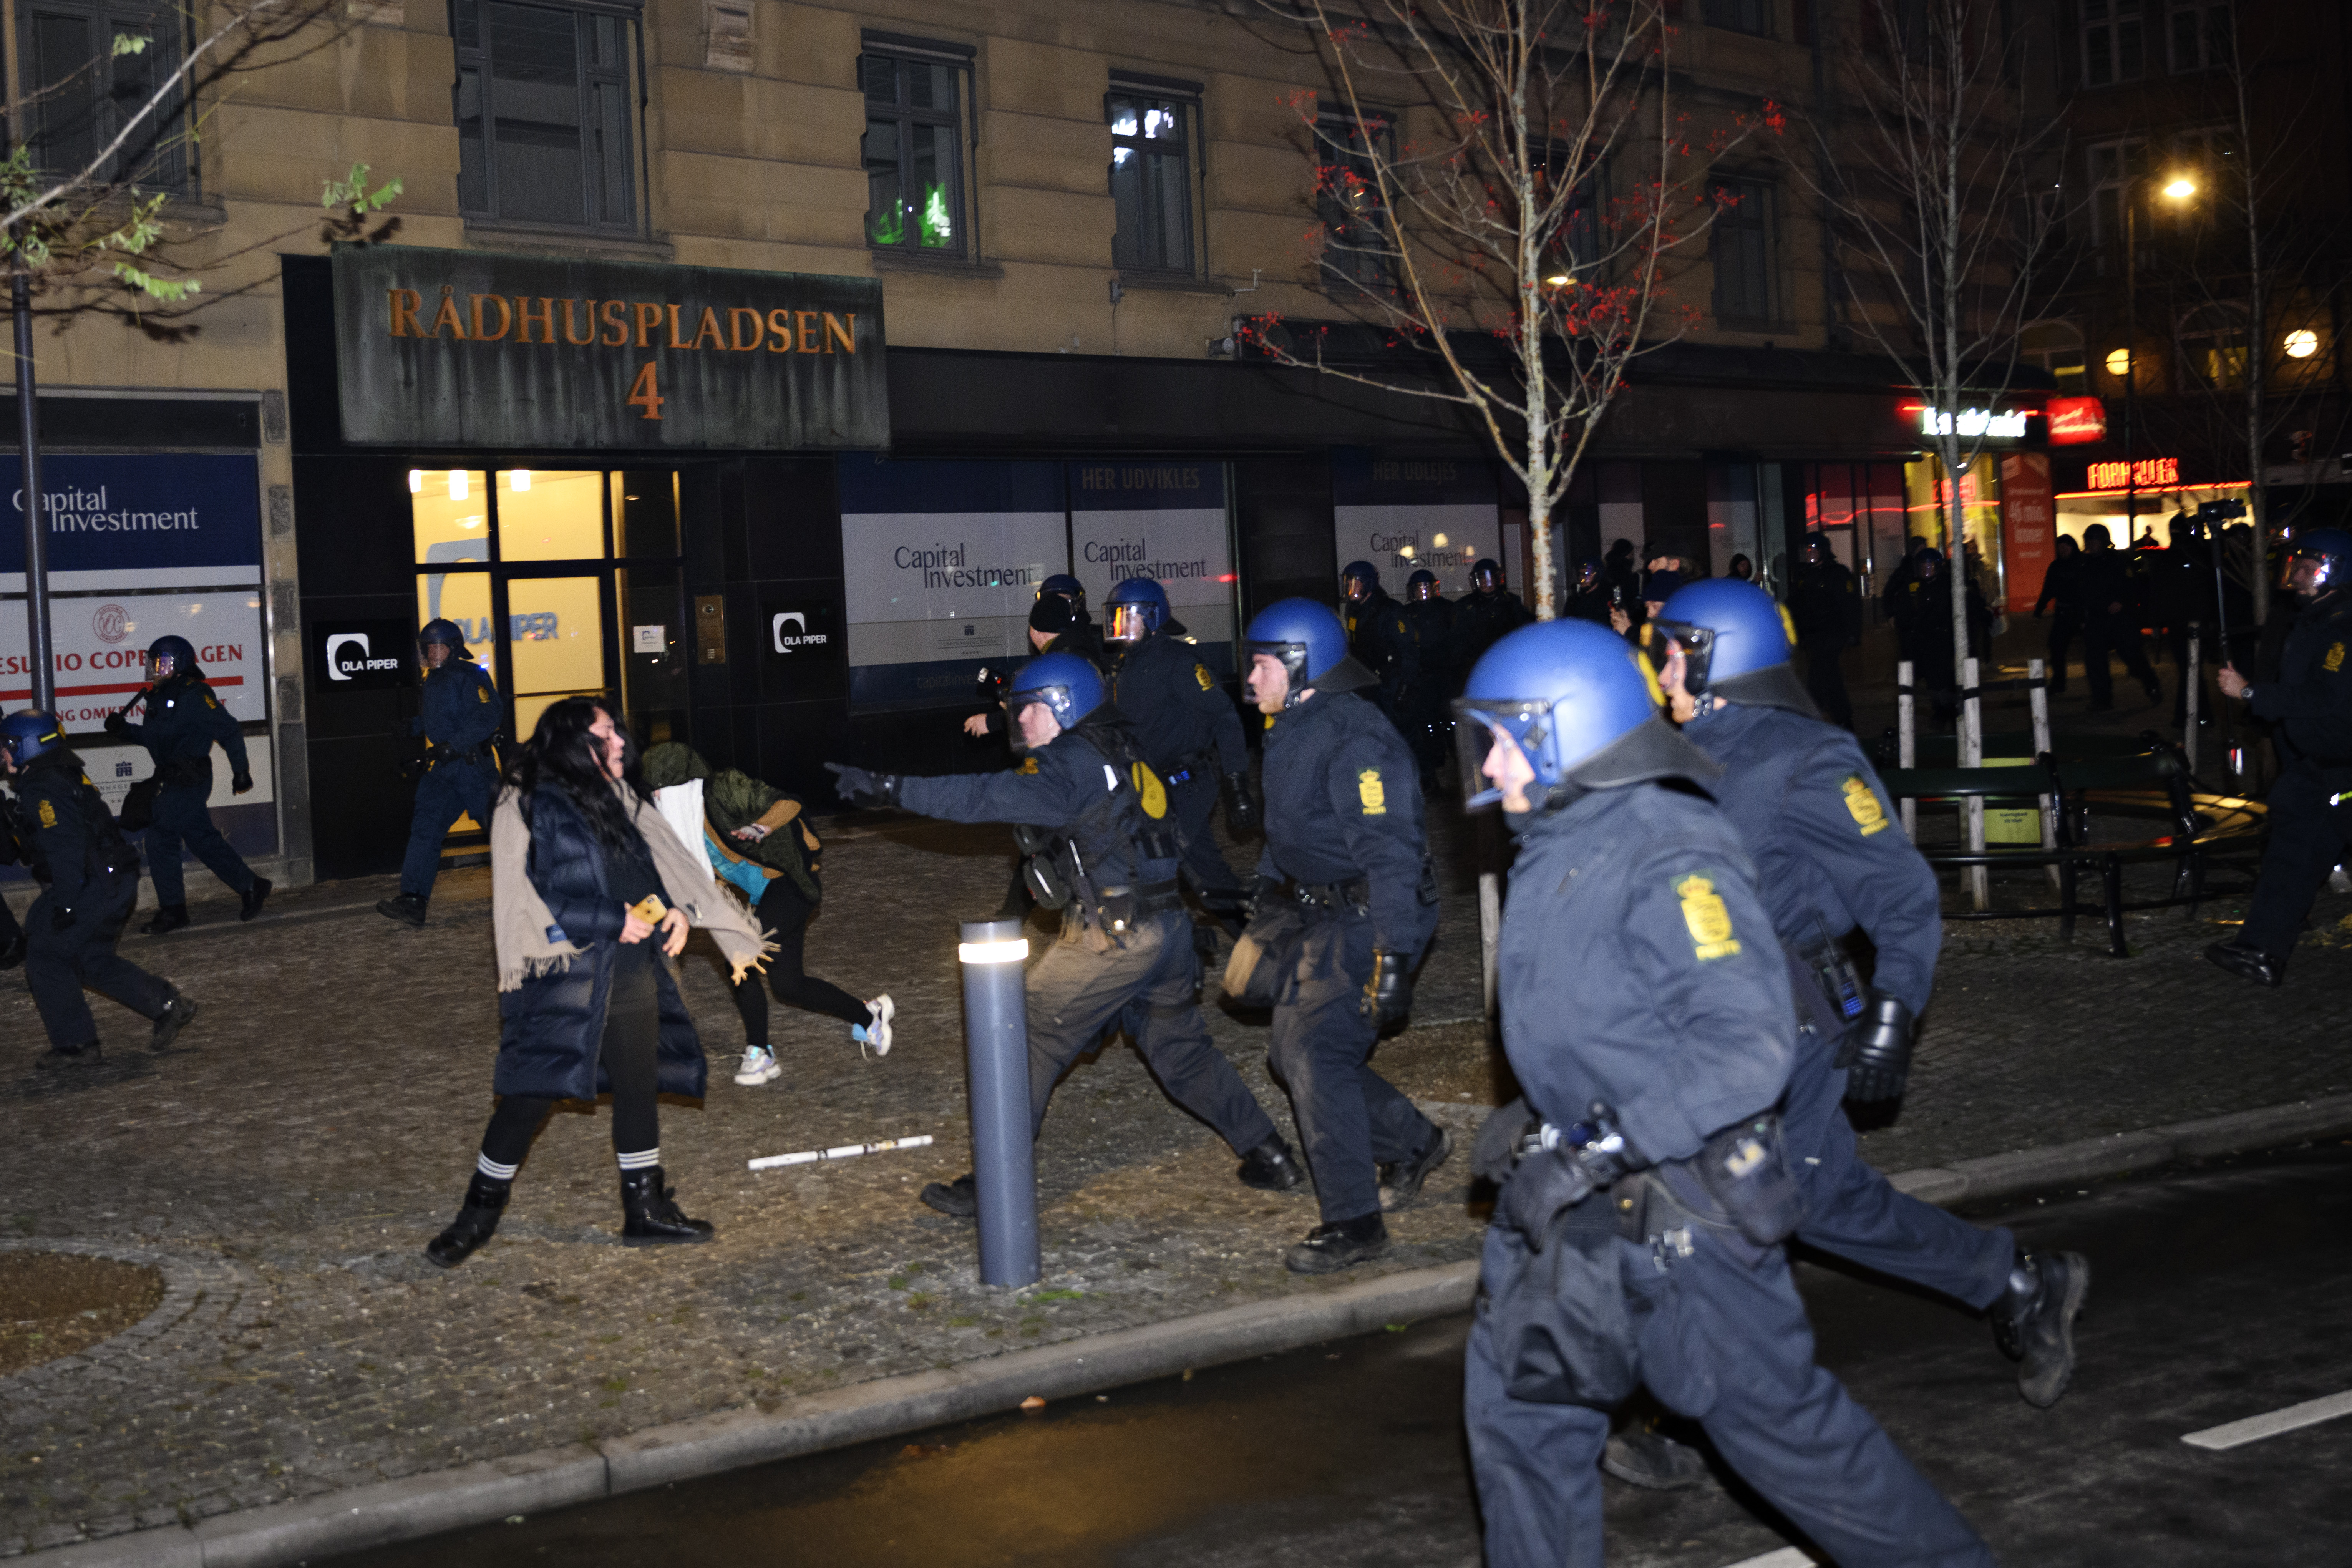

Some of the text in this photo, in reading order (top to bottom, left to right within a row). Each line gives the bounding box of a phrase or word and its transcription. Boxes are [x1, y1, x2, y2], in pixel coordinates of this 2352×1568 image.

[387, 285, 856, 355] RÅDHUSPLADSEN
[627, 361, 664, 420] 4
[1082, 468, 1201, 490] HER UDVIKLES
[52, 507, 199, 532] Investment
[1084, 538, 1146, 562] Capital
[1370, 530, 1419, 552] Capital
[894, 543, 965, 569] Capital
[1391, 550, 1467, 568] Investment
[924, 565, 1034, 589] Investment
[1110, 559, 1207, 581] Investment
[509, 612, 558, 641] IPER
[803, 635, 827, 644] PIPER
[0, 644, 242, 675] SUIO COPEGEN
[342, 658, 398, 672] DLA PIPER
[80, 704, 145, 720] OMKRIN
